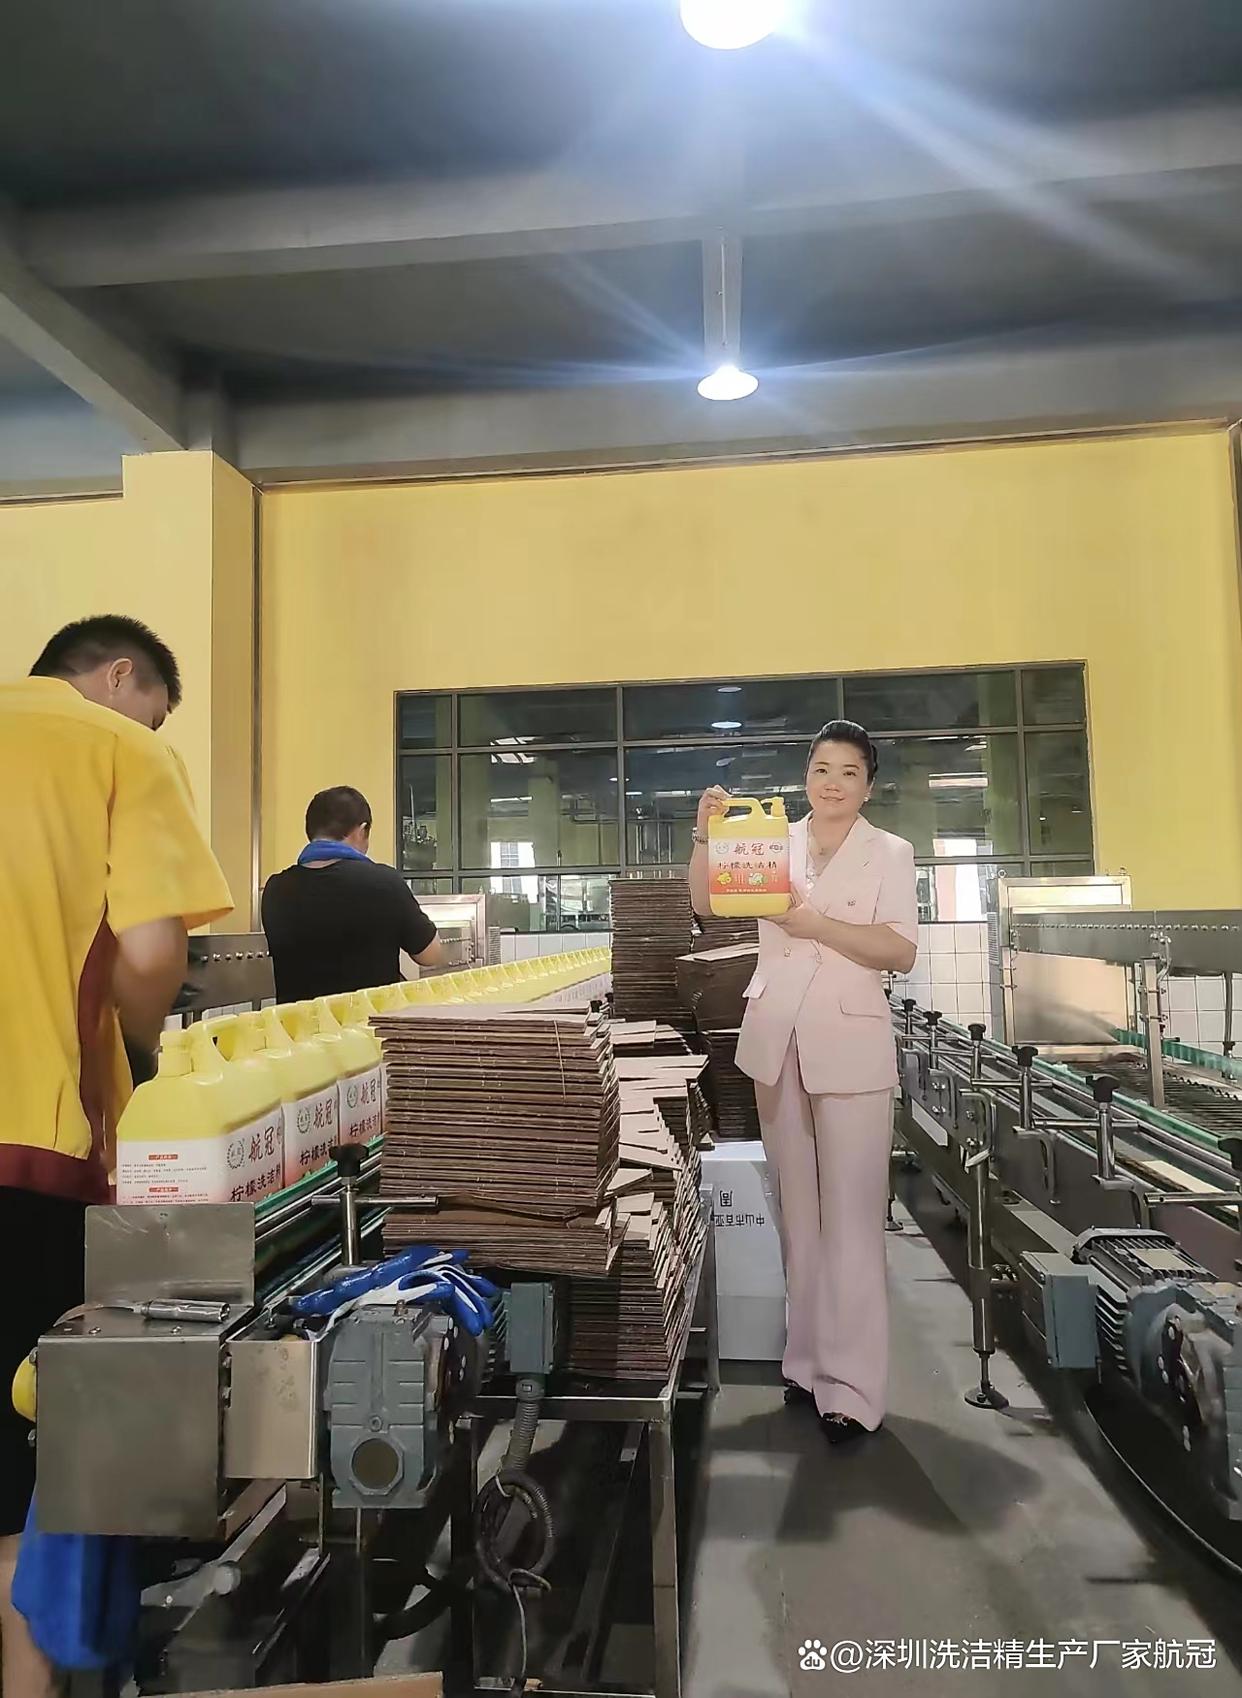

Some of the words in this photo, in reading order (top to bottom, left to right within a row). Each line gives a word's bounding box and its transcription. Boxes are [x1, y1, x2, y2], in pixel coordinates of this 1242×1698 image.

[248, 1126, 275, 1162] 航冠
[720, 1190, 733, 1207] 周
[714, 1213, 765, 1228] 中山市百亚
